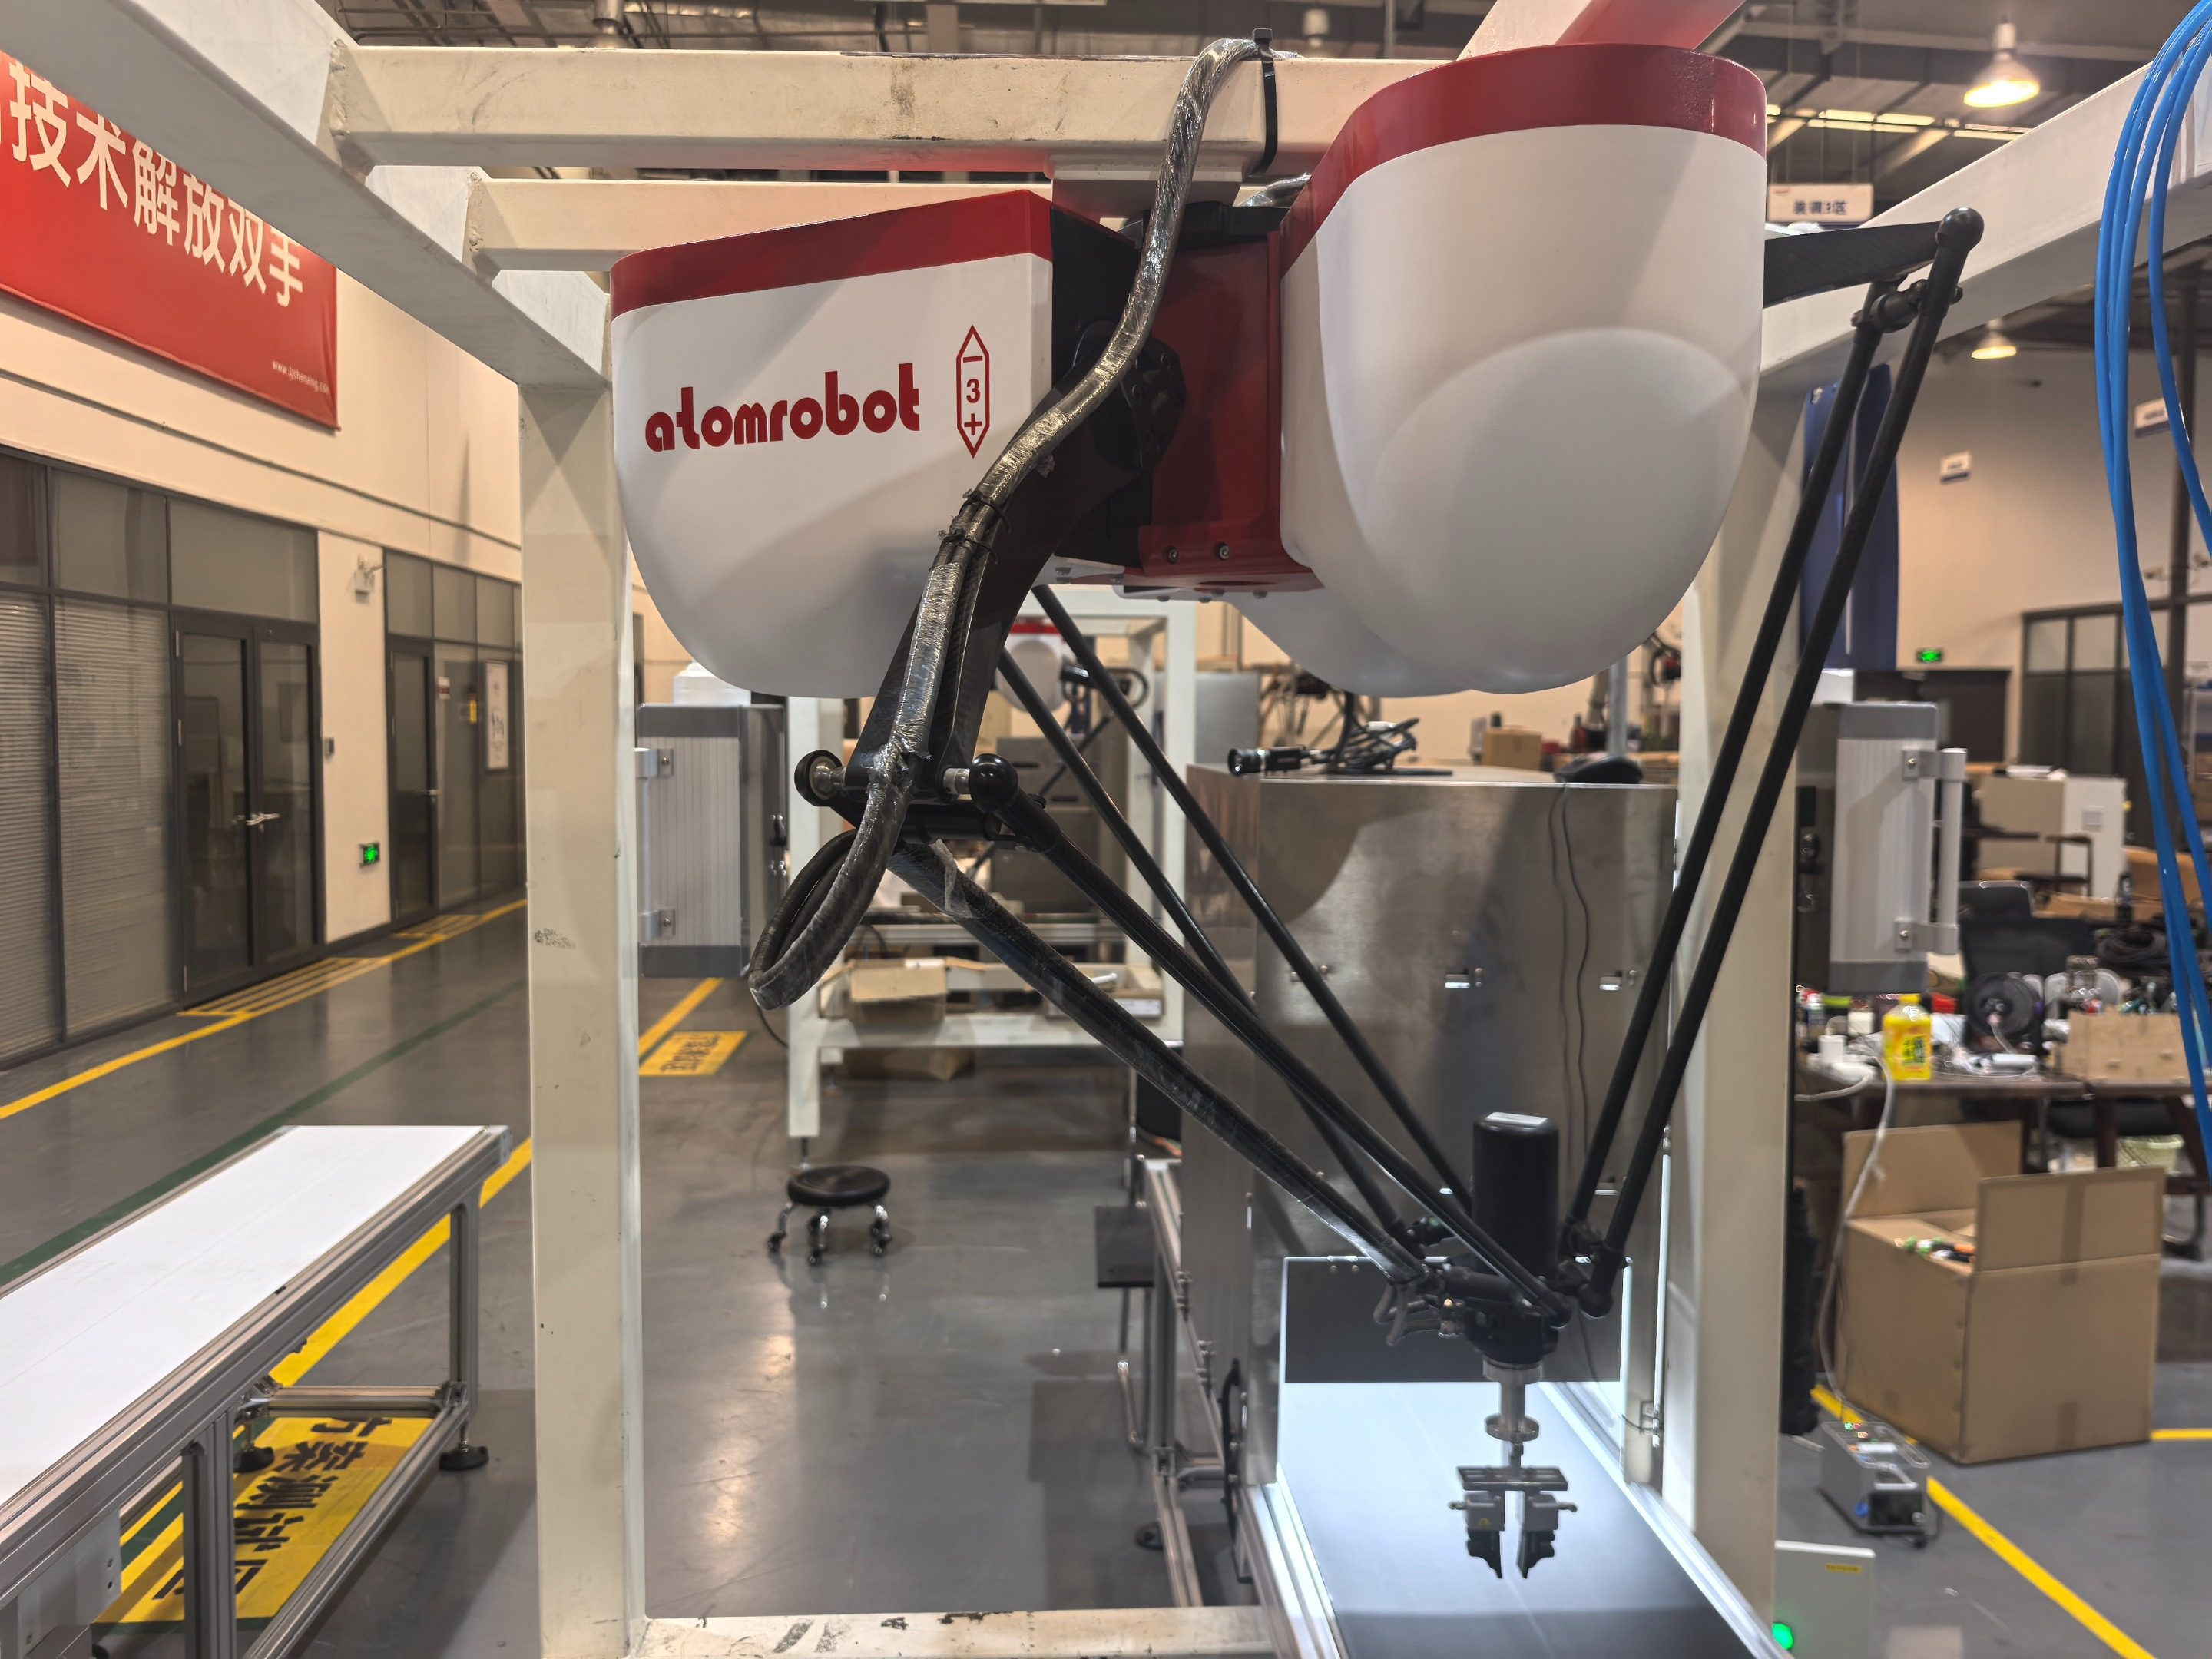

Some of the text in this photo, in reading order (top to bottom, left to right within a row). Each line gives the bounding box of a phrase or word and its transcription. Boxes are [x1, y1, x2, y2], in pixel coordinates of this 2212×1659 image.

[0, 59, 303, 306] 技术解放双手
[645, 363, 920, 452] atomrobot
